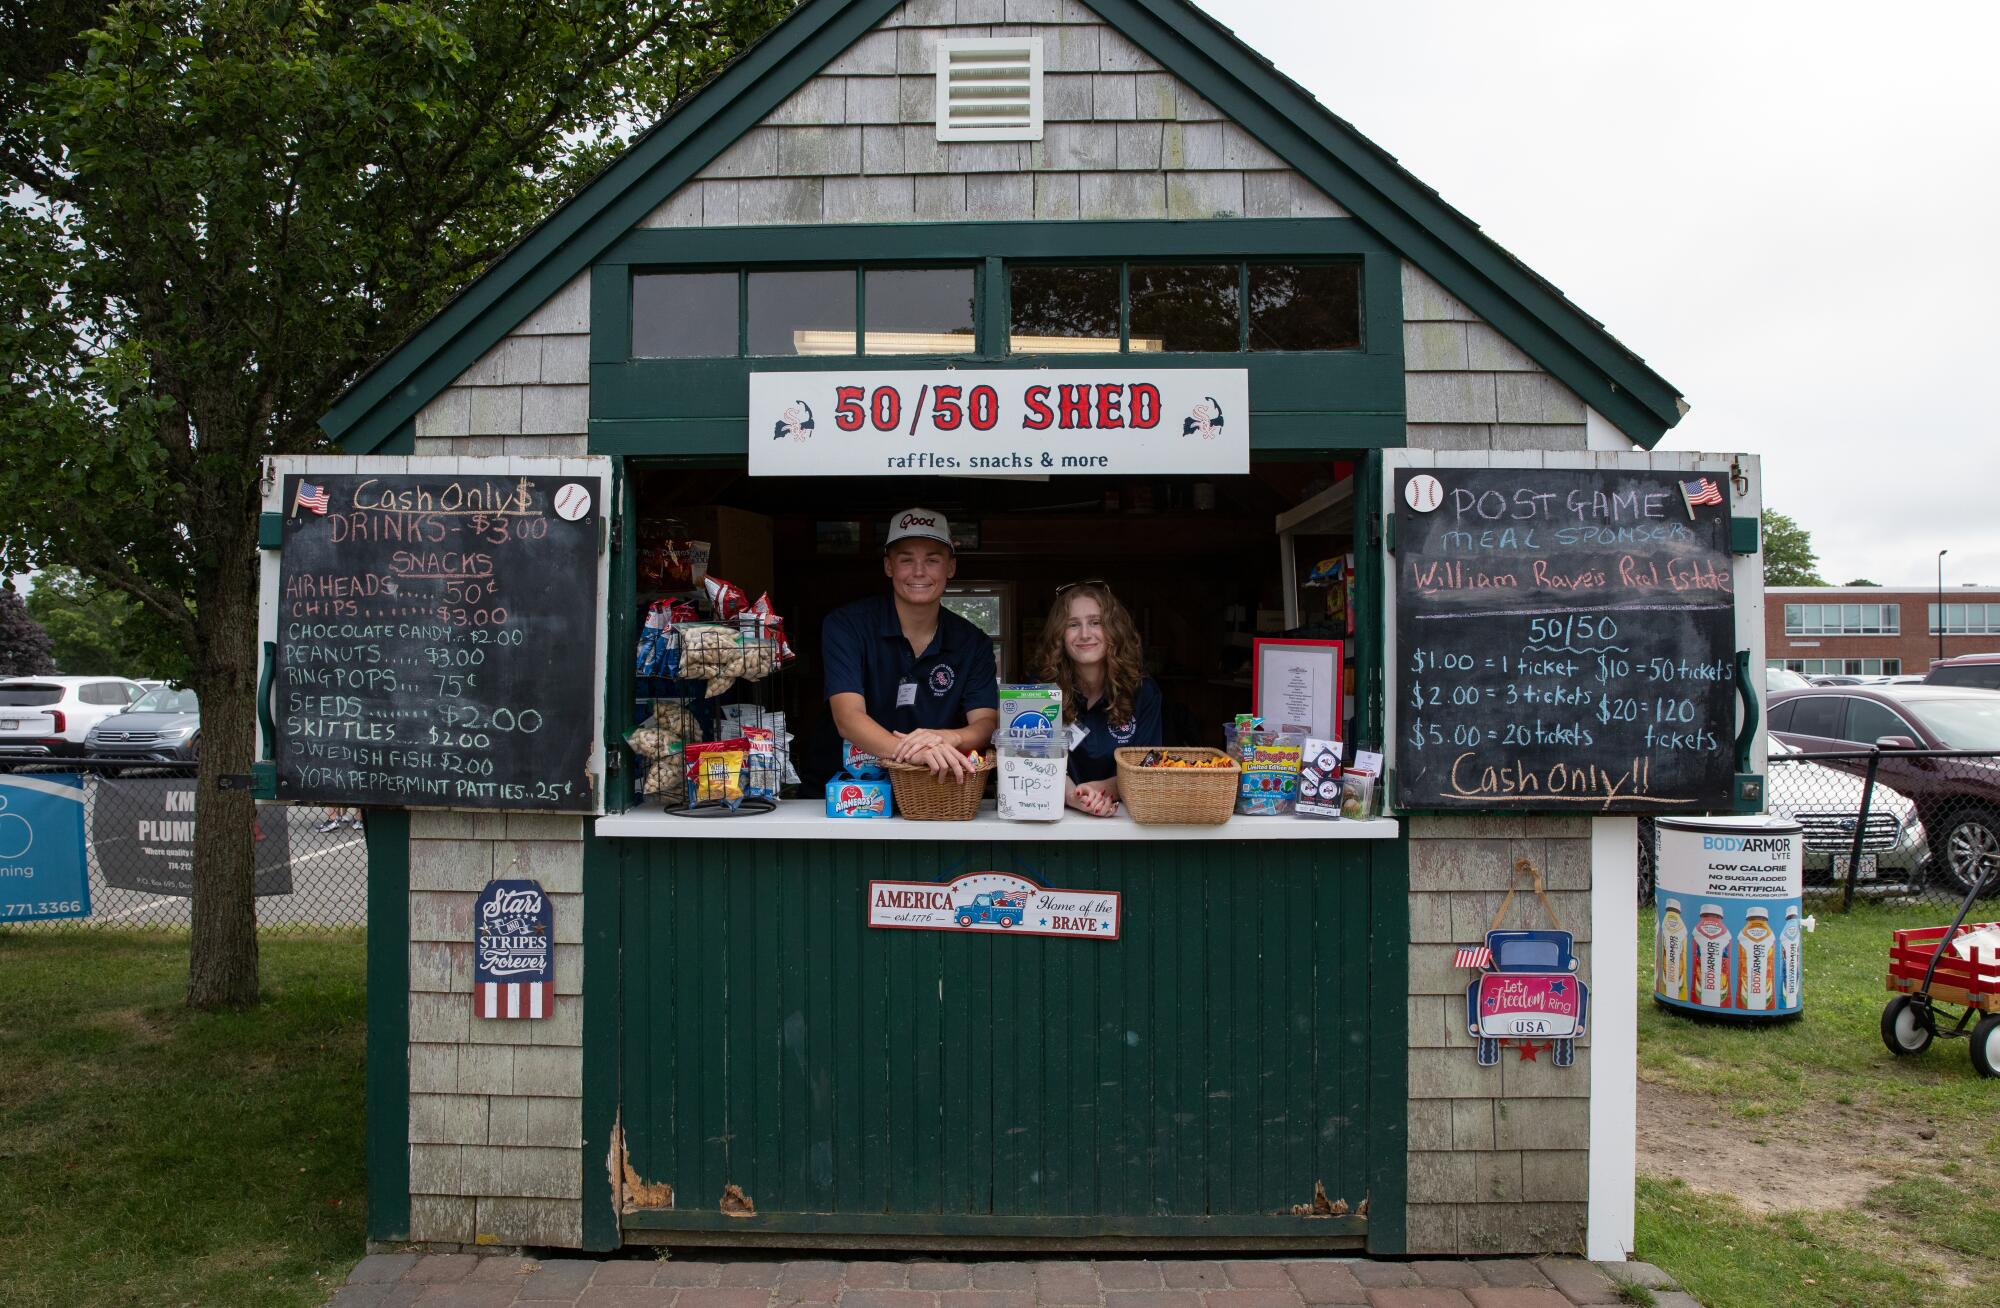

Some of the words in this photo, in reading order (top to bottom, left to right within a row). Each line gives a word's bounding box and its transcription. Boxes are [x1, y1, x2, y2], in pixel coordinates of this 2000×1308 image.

[834, 383, 999, 436] 50/50
[1022, 382, 1162, 430] SHED
[1040, 452, 1053, 467] &
[1061, 455, 1108, 467] more
[353, 478, 432, 512] Cash
[1450, 488, 1557, 523] POST
[1566, 488, 1670, 522] GAME
[327, 511, 446, 544] DRINKS
[467, 513, 548, 545] $3.00
[1440, 527, 1540, 551] MEAL
[388, 550, 494, 574] SNACKS
[1413, 560, 1518, 592] William
[1618, 555, 1659, 588] Real
[1666, 557, 1732, 593] Estate
[436, 606, 508, 627] $3.00
[289, 623, 394, 641] CHOCOLATE
[470, 629, 523, 646] $2.00
[1528, 614, 1618, 647] 50/50
[424, 647, 486, 668] $3.00
[1410, 647, 1474, 676] $1.00
[1517, 654, 1579, 677] ticket
[1677, 654, 1733, 682] tickets
[433, 672, 477, 698] 75¢
[1410, 680, 1480, 710] $2.00
[1506, 684, 1518, 705] 3
[1523, 684, 1593, 707] tickets
[438, 704, 543, 734] $2.00
[1595, 693, 1638, 725] $20
[1654, 697, 1696, 723] 120
[428, 725, 490, 748] $2.00
[1409, 717, 1482, 750] $5.00
[1501, 723, 1531, 746] 20
[1535, 719, 1593, 748] tickets
[1644, 724, 1718, 751] tickets
[291, 740, 383, 767] SWEDISH
[295, 763, 346, 790] YORK
[348, 770, 451, 795] PEPPERMINT
[1008, 775, 1041, 796] Tips
[1451, 752, 1539, 796] Cash
[138, 820, 195, 842] PLUM
[166, 848, 189, 858] quality
[1703, 836, 1791, 852] BODYARMOR
[1772, 852, 1791, 860] LYTE
[0, 864, 34, 878] ning
[1708, 863, 1738, 871] LOW
[1740, 864, 1787, 872] CALORIE
[874, 889, 955, 911] AMERICA
[1708, 883, 1727, 891] NO
[1729, 885, 1786, 893] ARTIFICIAL
[0, 900, 81, 917] .771.3366
[483, 888, 542, 922] Stars
[1036, 895, 1076, 911] Home
[1079, 898, 1092, 916] of
[1094, 898, 1113, 914] the
[506, 919, 520, 934] AND
[1052, 915, 1098, 932] BRAVE
[479, 936, 547, 949] STRIPES
[480, 949, 547, 976] Forever
[1706, 942, 1716, 990] BODYARMOR
[1753, 944, 1761, 994] BODYARMOR
[1503, 979, 1523, 993] Let
[1491, 985, 1545, 1013] Freedom
[1547, 997, 1572, 1014] Ring
[1515, 1021, 1545, 1033] USA
